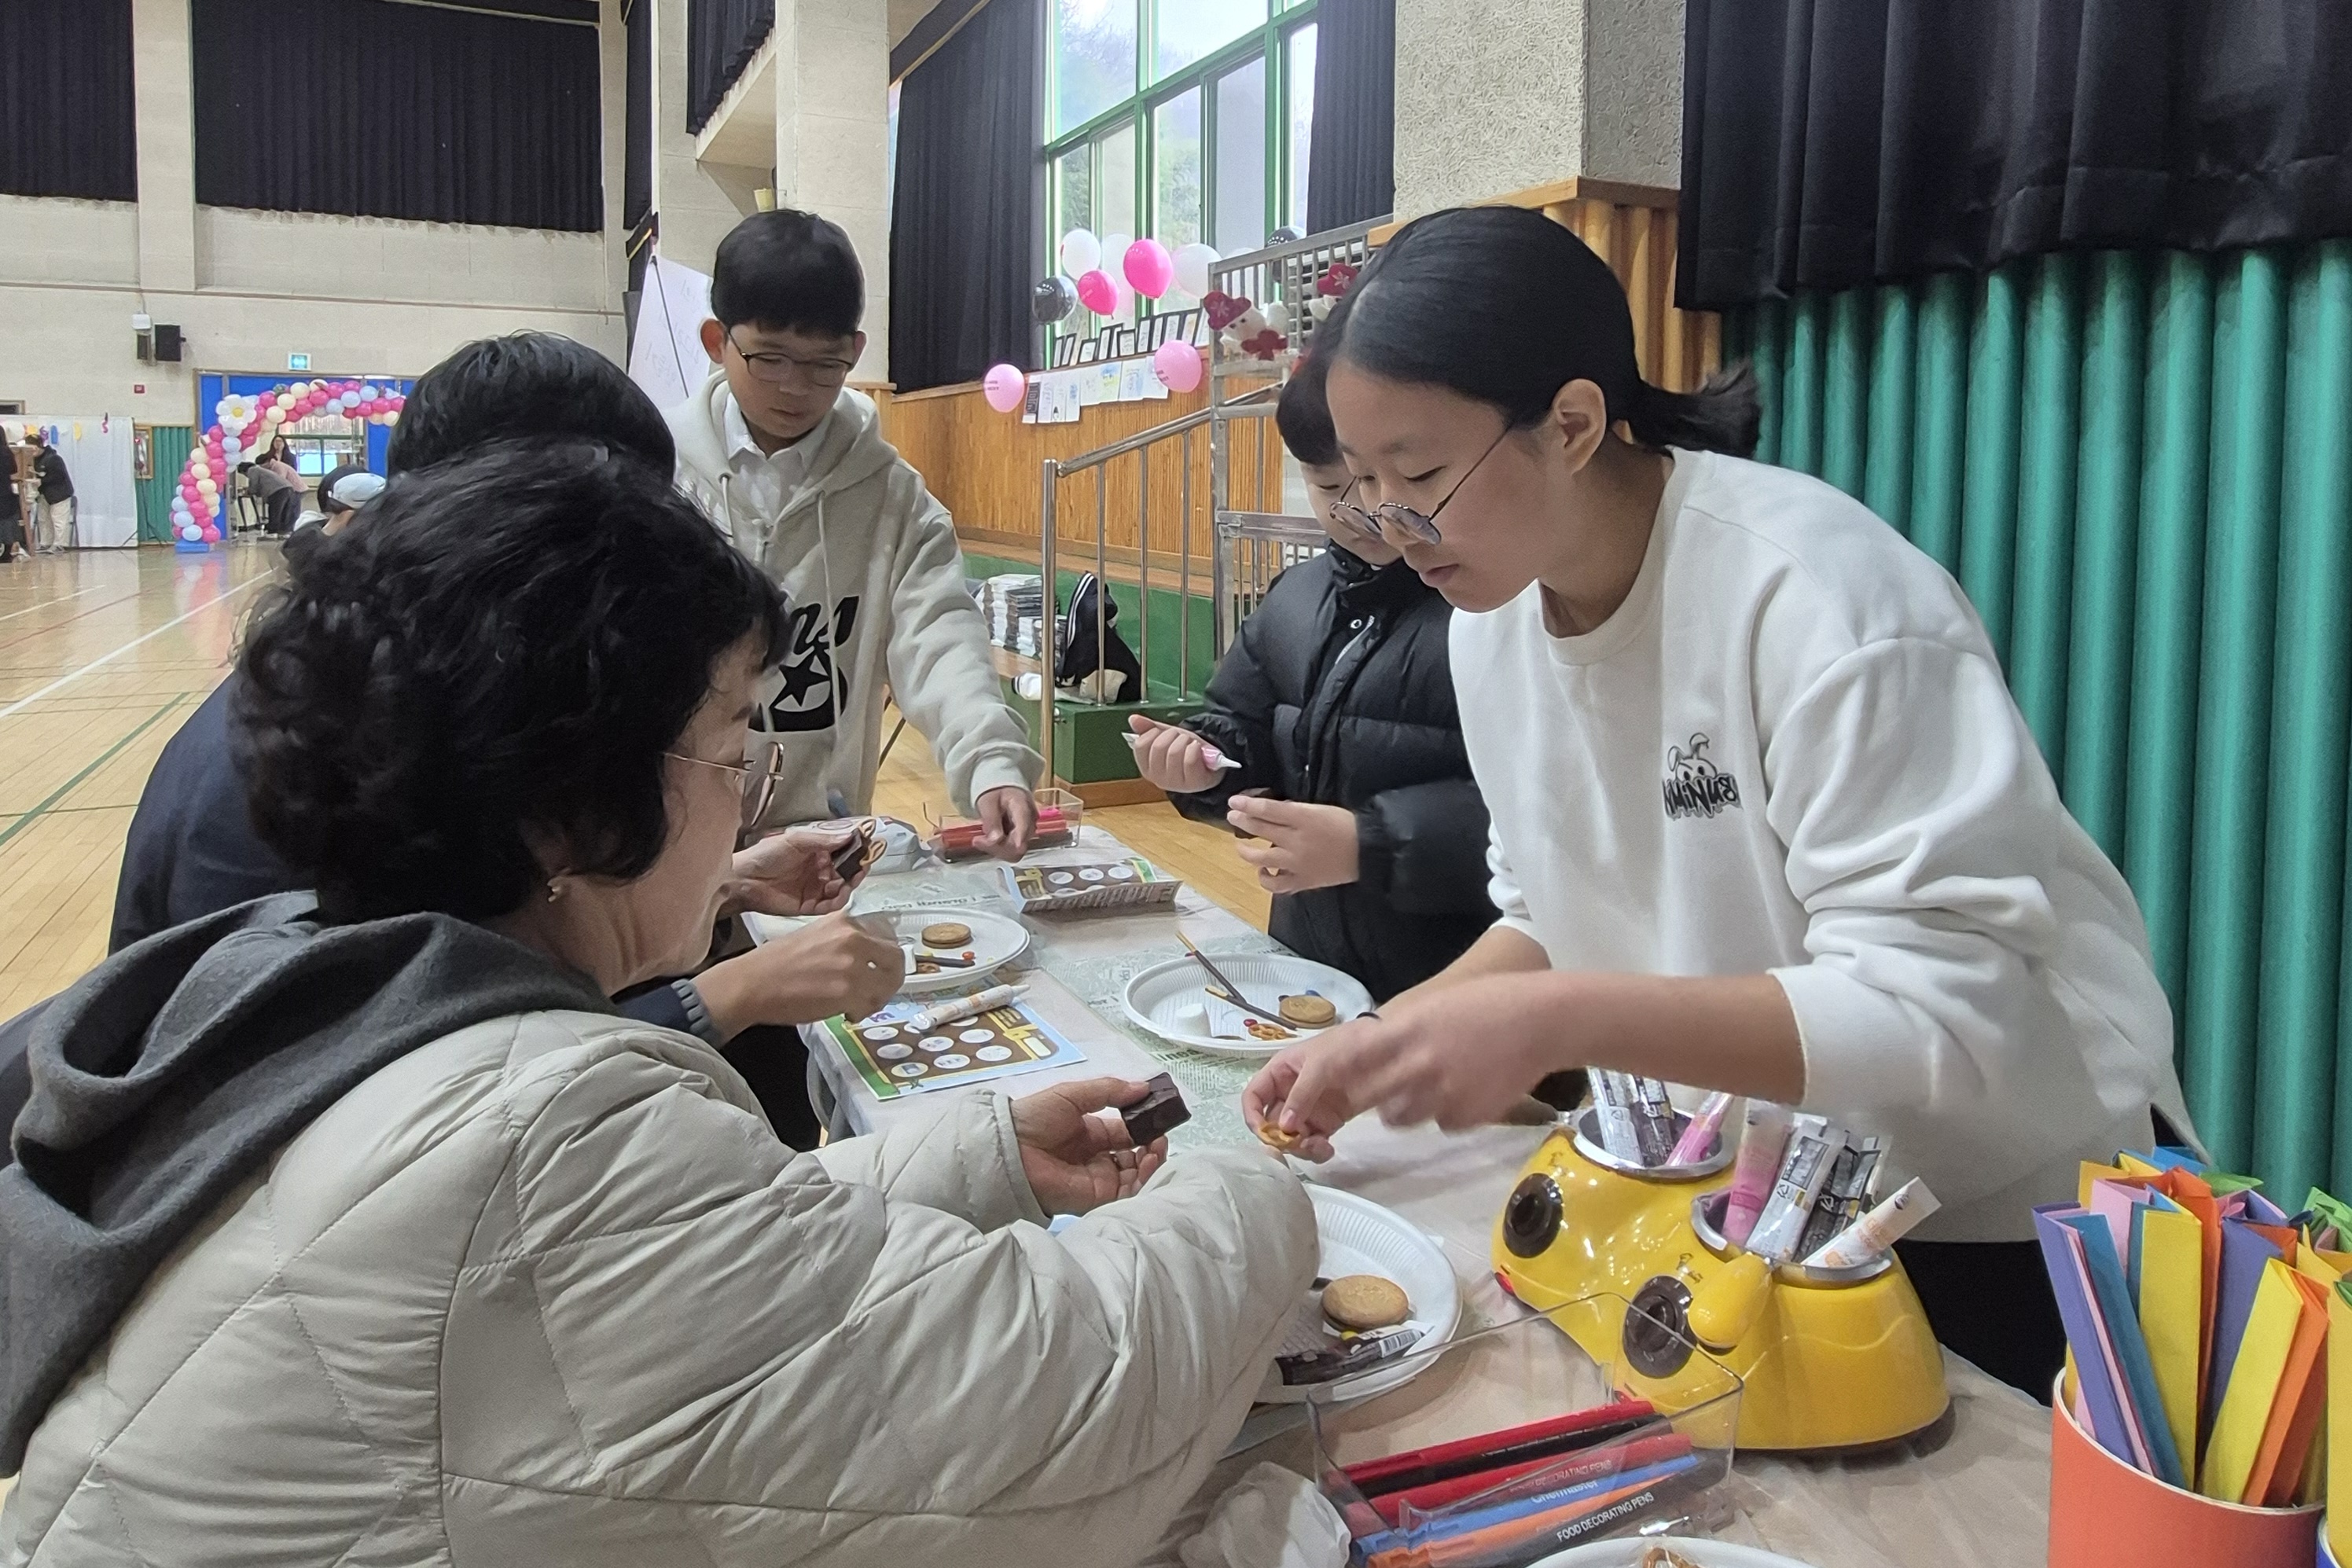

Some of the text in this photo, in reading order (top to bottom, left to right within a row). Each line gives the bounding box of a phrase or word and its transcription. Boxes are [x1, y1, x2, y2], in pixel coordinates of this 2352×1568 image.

[1556, 1524, 1582, 1542] FOOD
[1580, 1501, 1633, 1532] DECORATING
[1631, 1492, 1655, 1510] PENS
